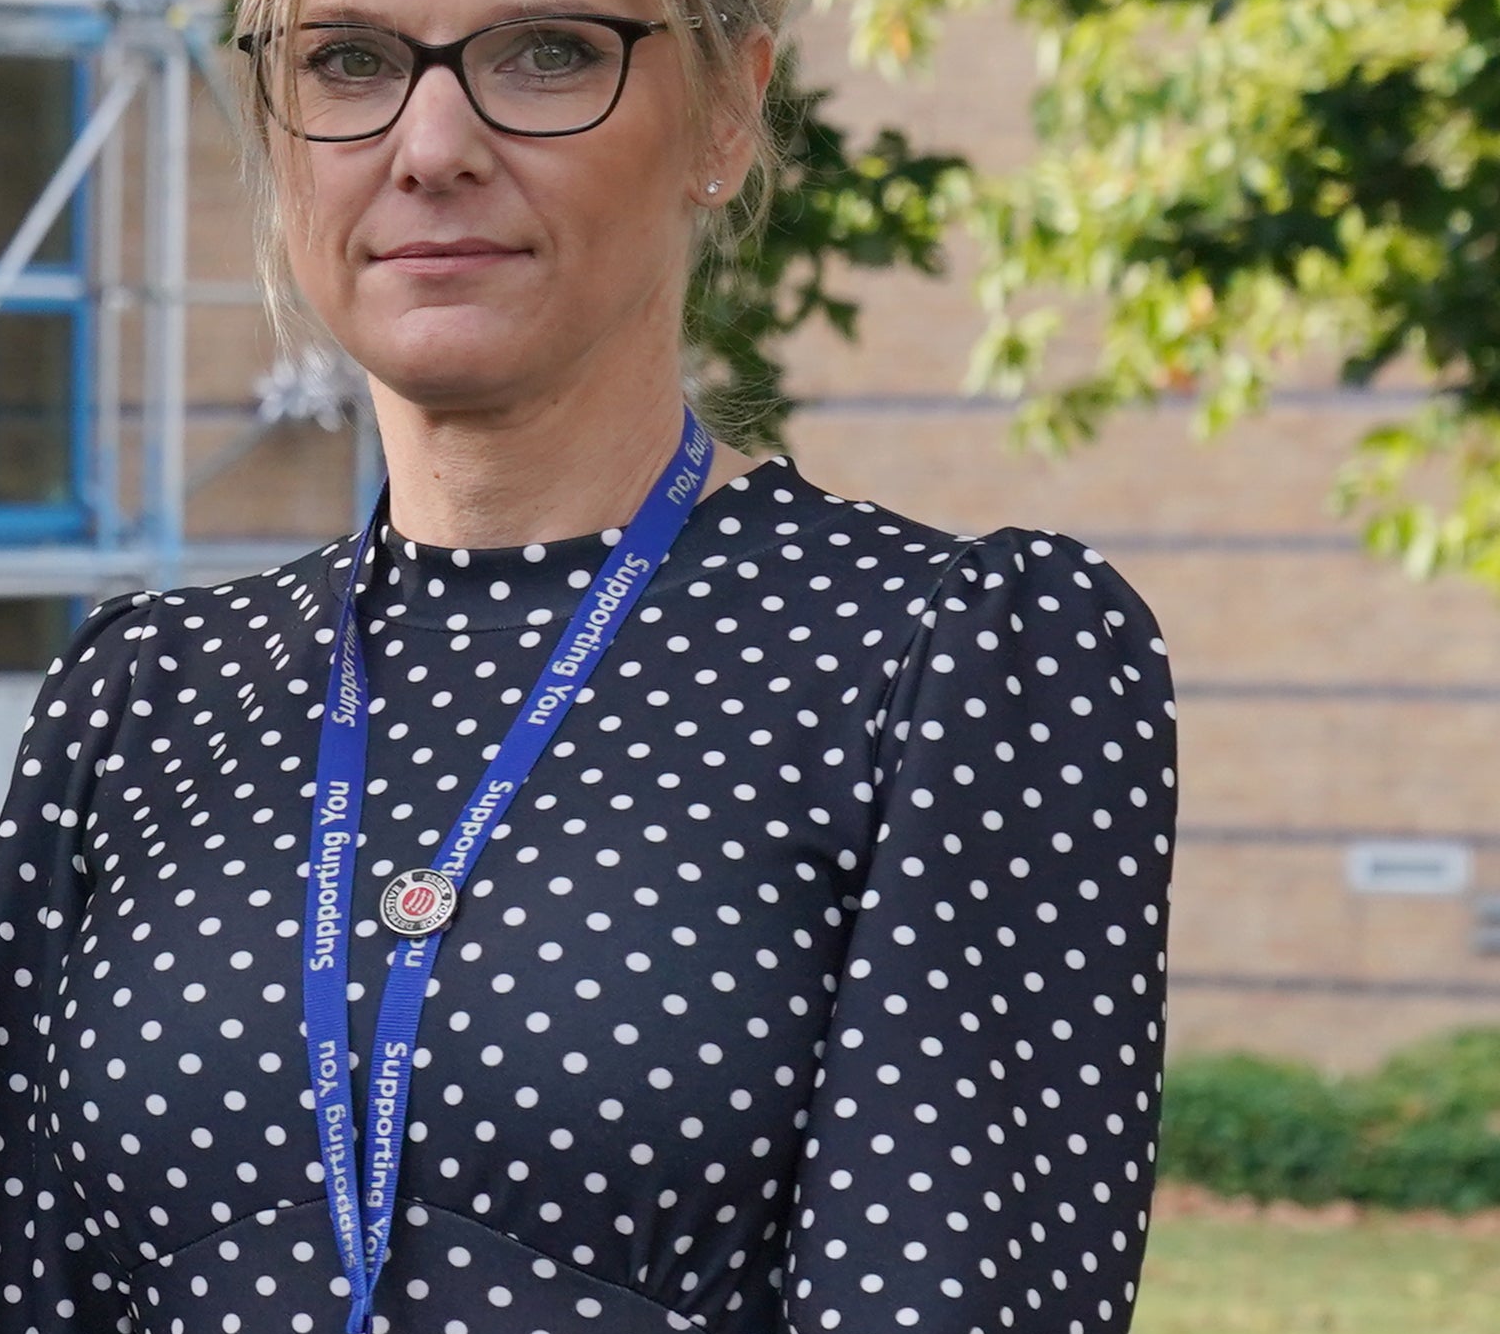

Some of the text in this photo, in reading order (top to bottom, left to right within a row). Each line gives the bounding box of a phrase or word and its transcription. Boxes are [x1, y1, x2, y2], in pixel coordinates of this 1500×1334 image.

[666, 466, 701, 505] You
[527, 552, 650, 726] Supporting You
[309, 780, 351, 971] Supporting You
[404, 779, 514, 967] Supporti ou
[317, 1039, 357, 1268] Supporting You
[366, 1041, 408, 1208] Supporting
